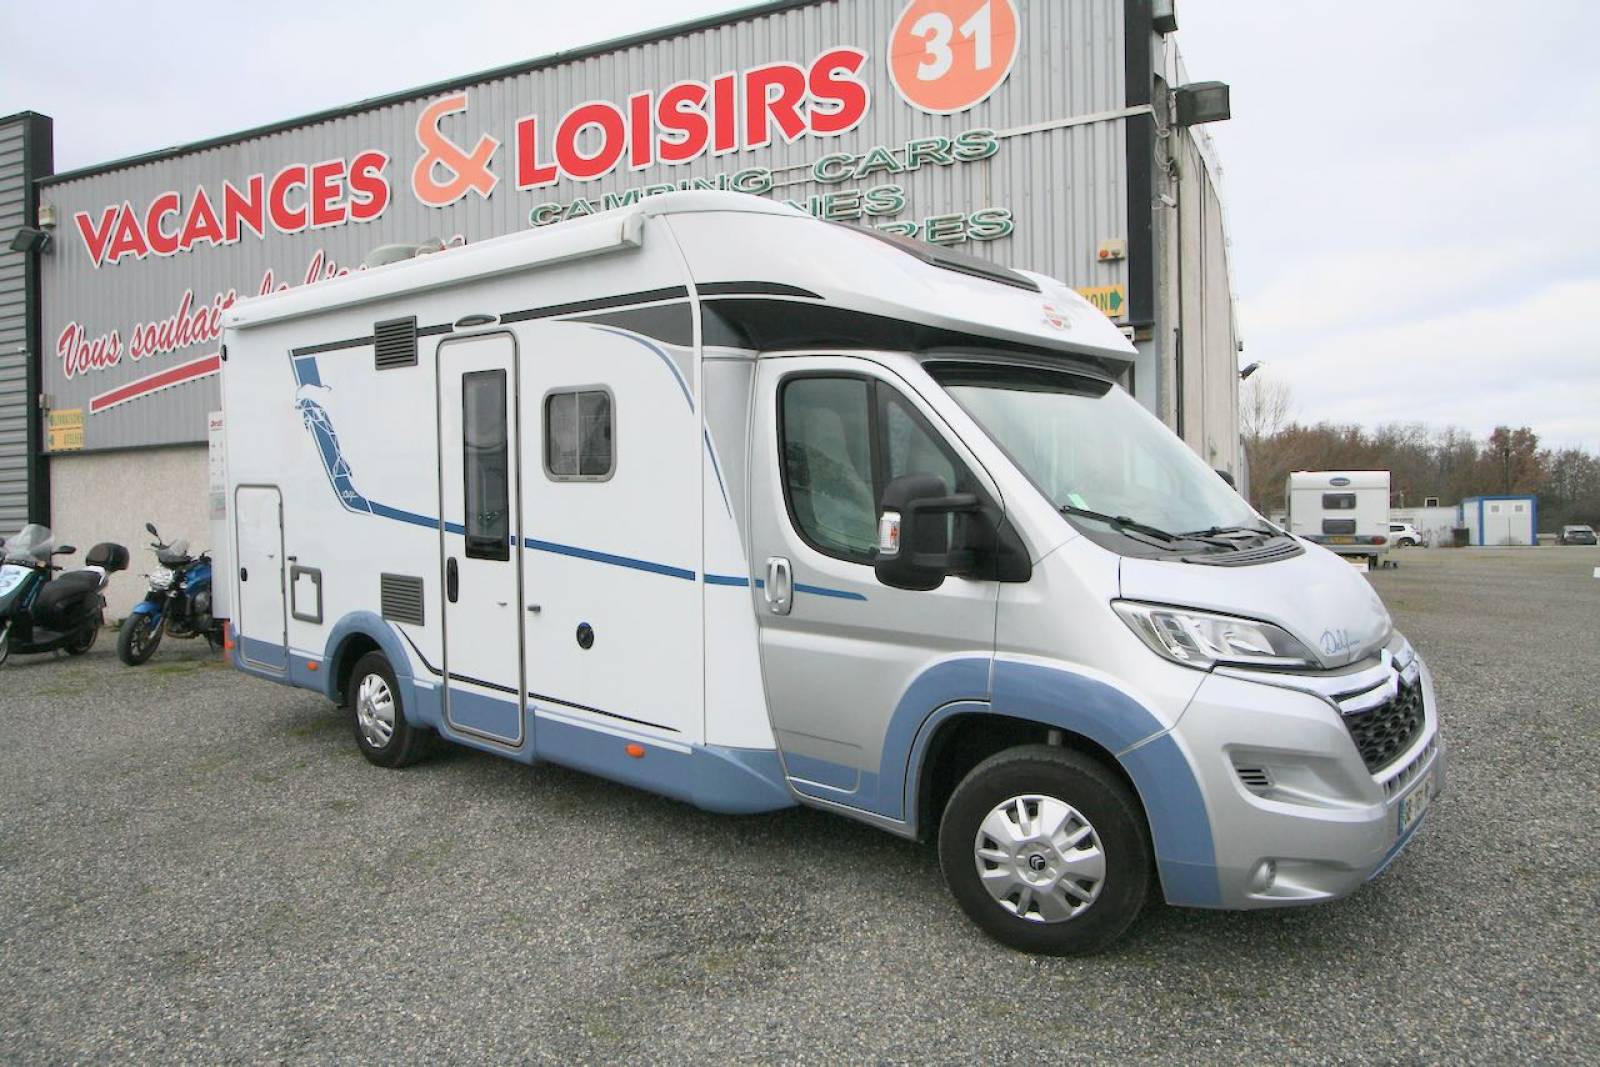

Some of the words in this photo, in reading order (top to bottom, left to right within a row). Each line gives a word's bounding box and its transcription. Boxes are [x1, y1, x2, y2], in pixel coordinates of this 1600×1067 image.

[75, 149, 391, 269] VACANCES
[411, 92, 500, 208] &
[515, 45, 871, 192] LOISIRS
[910, 1, 992, 81] 31
[813, 127, 1000, 184] CARS
[58, 321, 122, 380] Vous
